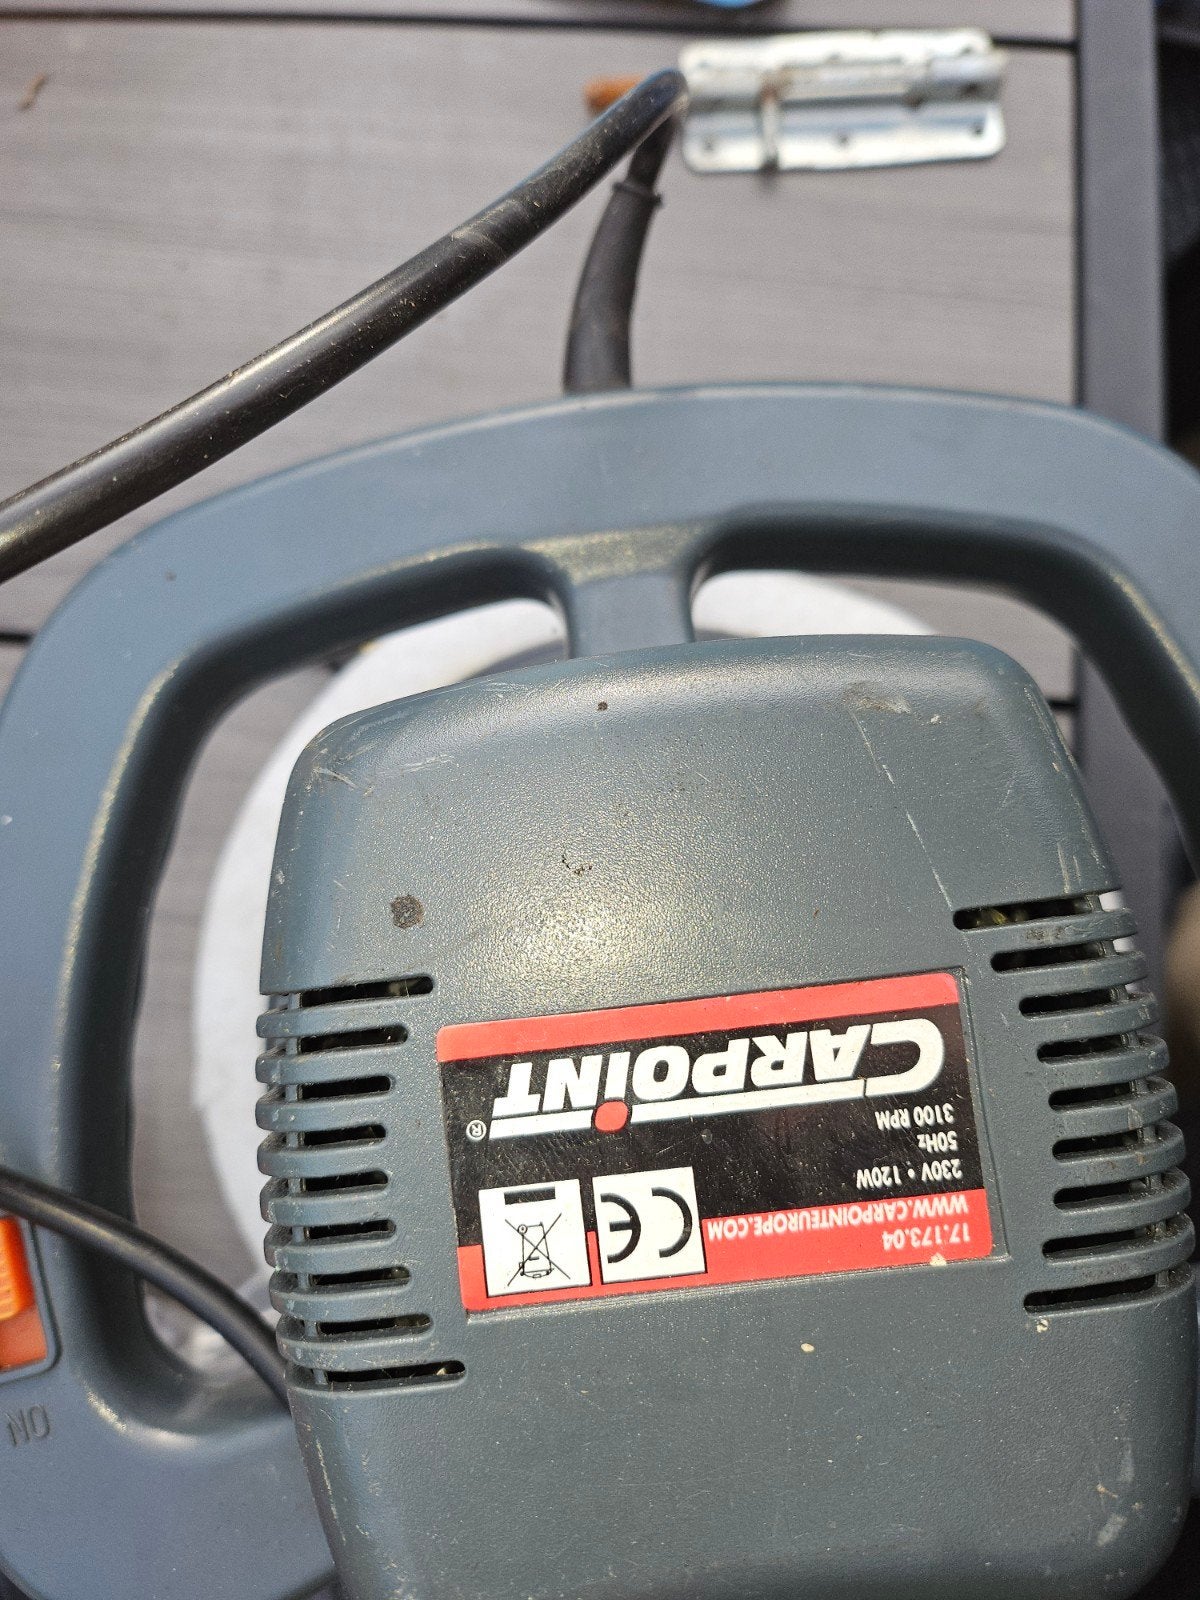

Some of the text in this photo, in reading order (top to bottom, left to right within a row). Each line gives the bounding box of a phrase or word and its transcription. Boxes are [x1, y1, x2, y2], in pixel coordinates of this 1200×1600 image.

[874, 1102, 955, 1131] 3100 RPM
[917, 1129, 959, 1154] 50Hz
[855, 1159, 963, 1190] 230V 120W
[706, 1193, 969, 1243] WWW.CARPOINTEUROPE.COM
[882, 1222, 970, 1249] 17.173.04
